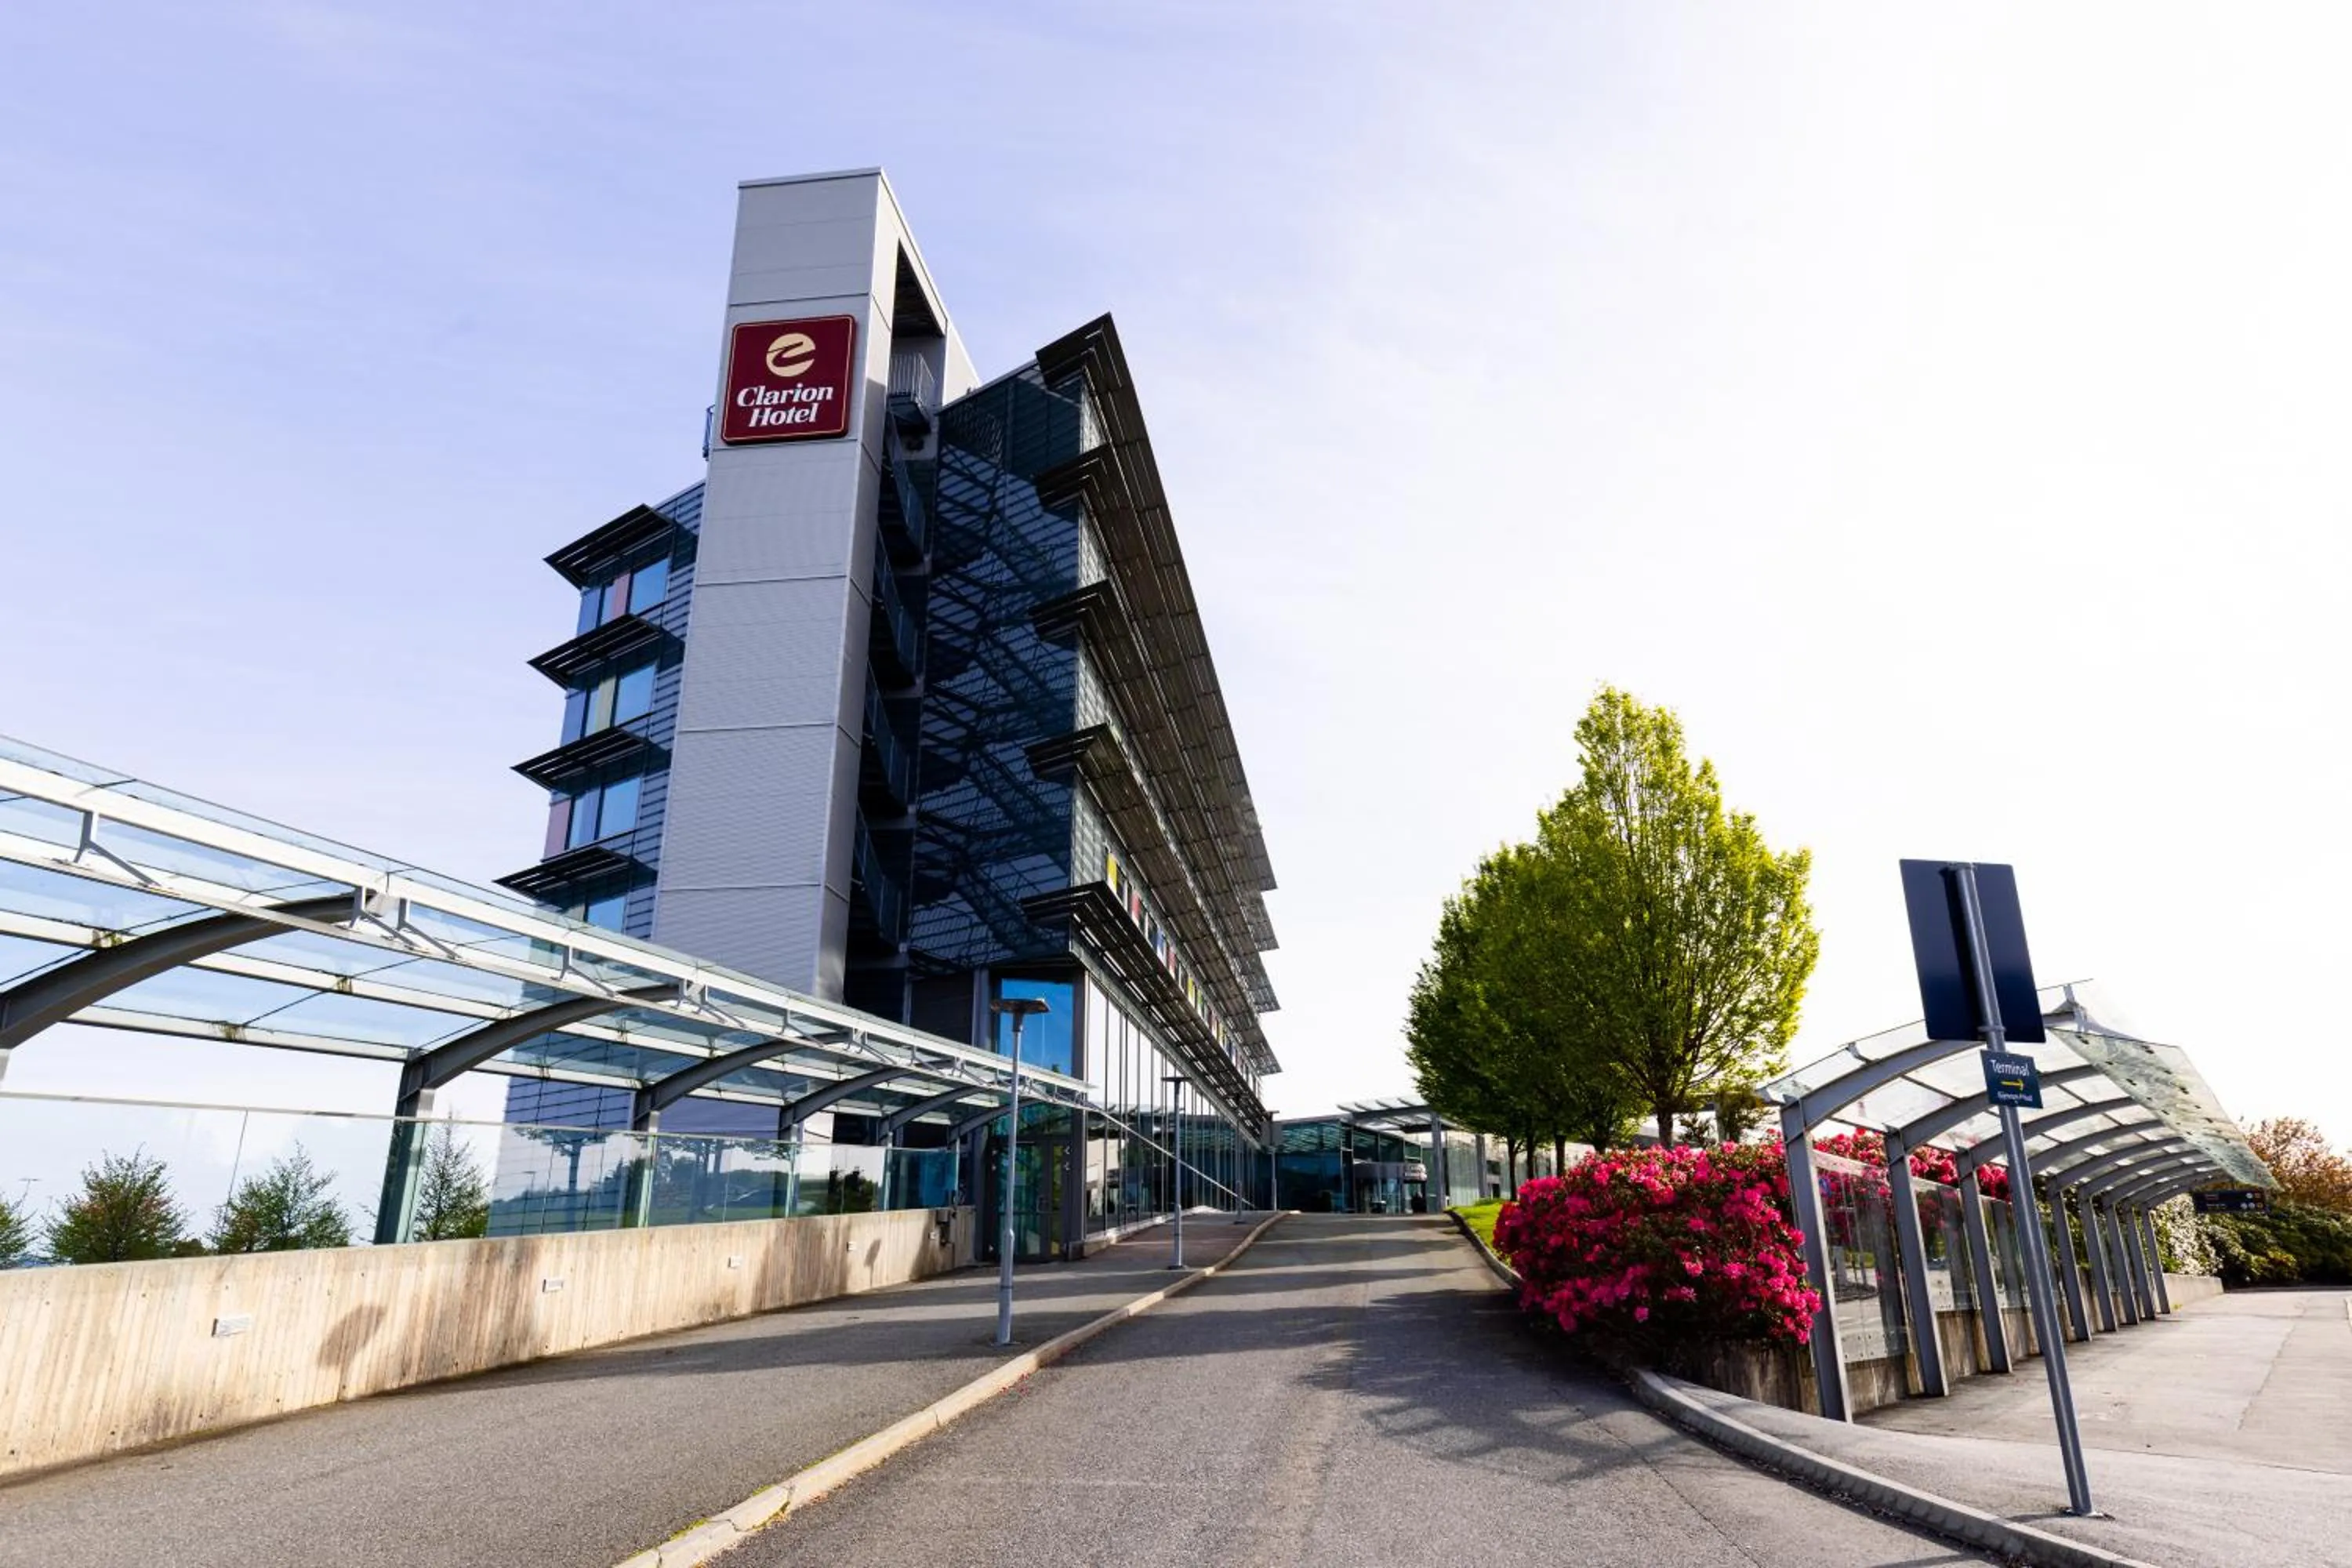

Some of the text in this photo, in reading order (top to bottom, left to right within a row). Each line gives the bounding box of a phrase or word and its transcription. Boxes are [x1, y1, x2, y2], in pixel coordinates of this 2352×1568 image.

[736, 383, 833, 407] Clarion
[749, 402, 818, 427] Hotel
[1990, 1059, 2029, 1076] Terminal
